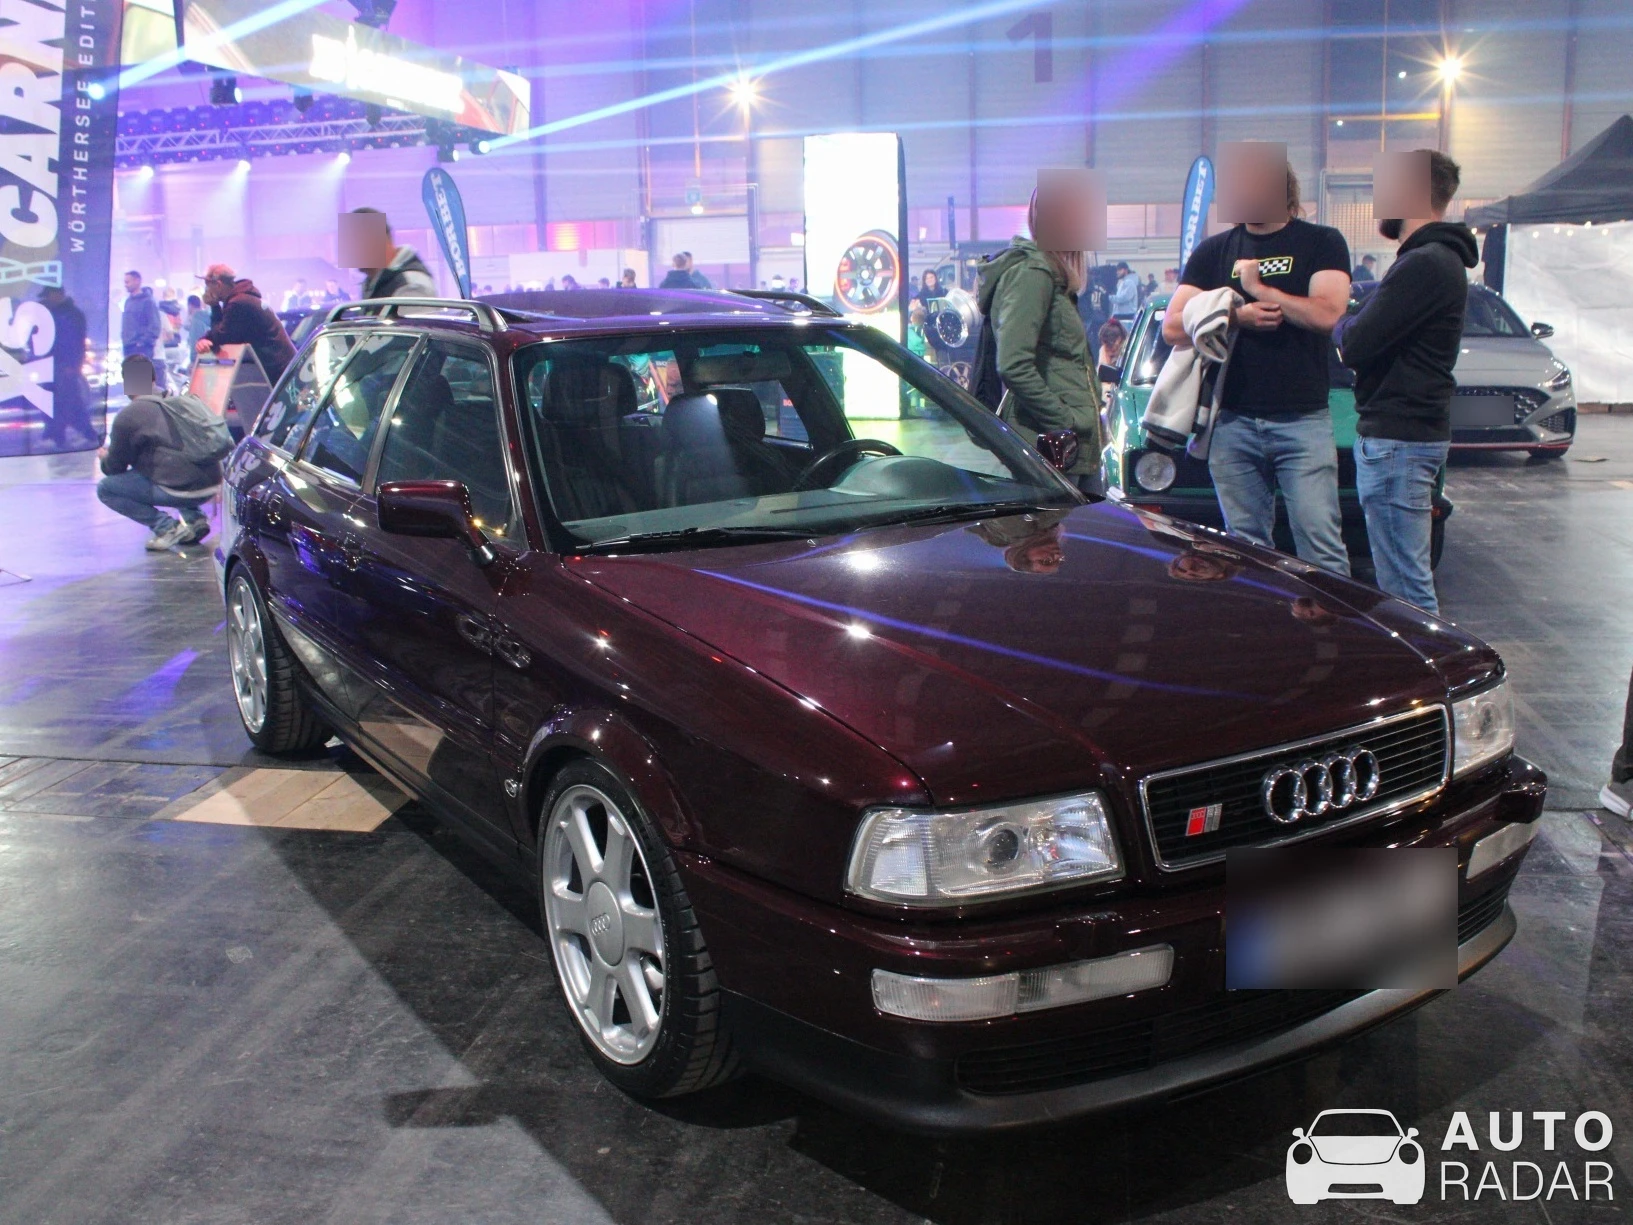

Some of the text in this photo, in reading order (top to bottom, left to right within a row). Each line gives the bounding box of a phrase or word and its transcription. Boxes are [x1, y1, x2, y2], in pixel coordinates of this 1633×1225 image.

[0, 0, 66, 248] CARN
[70, 0, 96, 253] WÖRTHERSEE EDIT
[430, 172, 467, 278] BORBET
